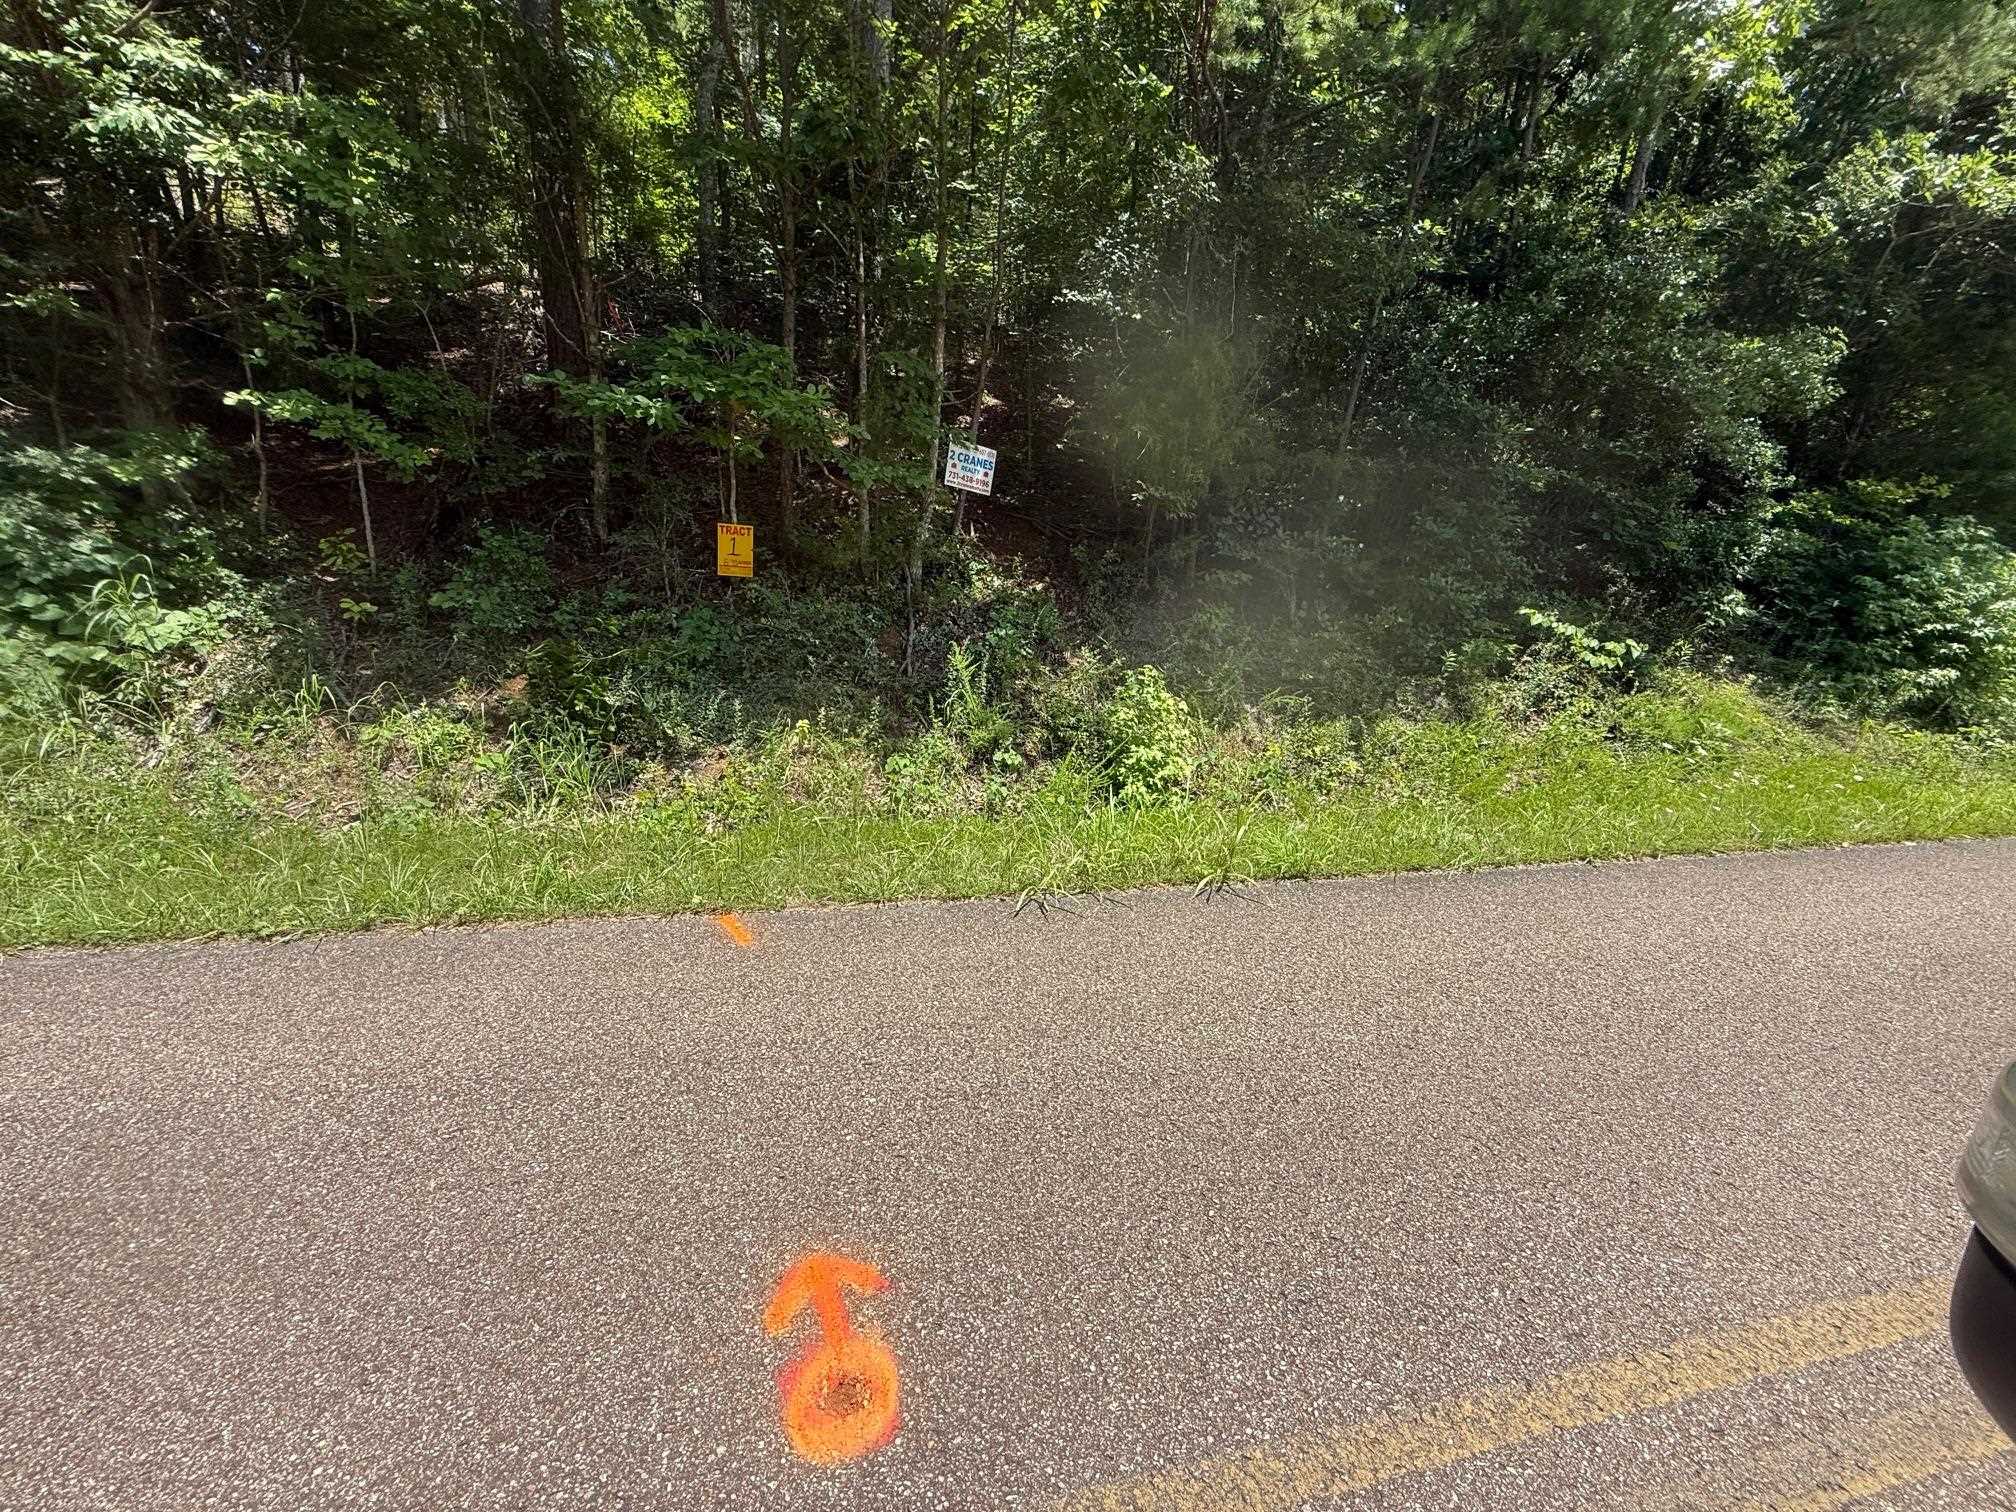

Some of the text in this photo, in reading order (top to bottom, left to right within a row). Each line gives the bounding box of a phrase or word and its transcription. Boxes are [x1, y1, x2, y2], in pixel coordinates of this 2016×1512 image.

[949, 450, 955, 460] 2
[957, 452, 993, 470] CRANES
[961, 465, 980, 475] REALTY
[719, 525, 752, 536] TRACT
[728, 536, 741, 556] 1
